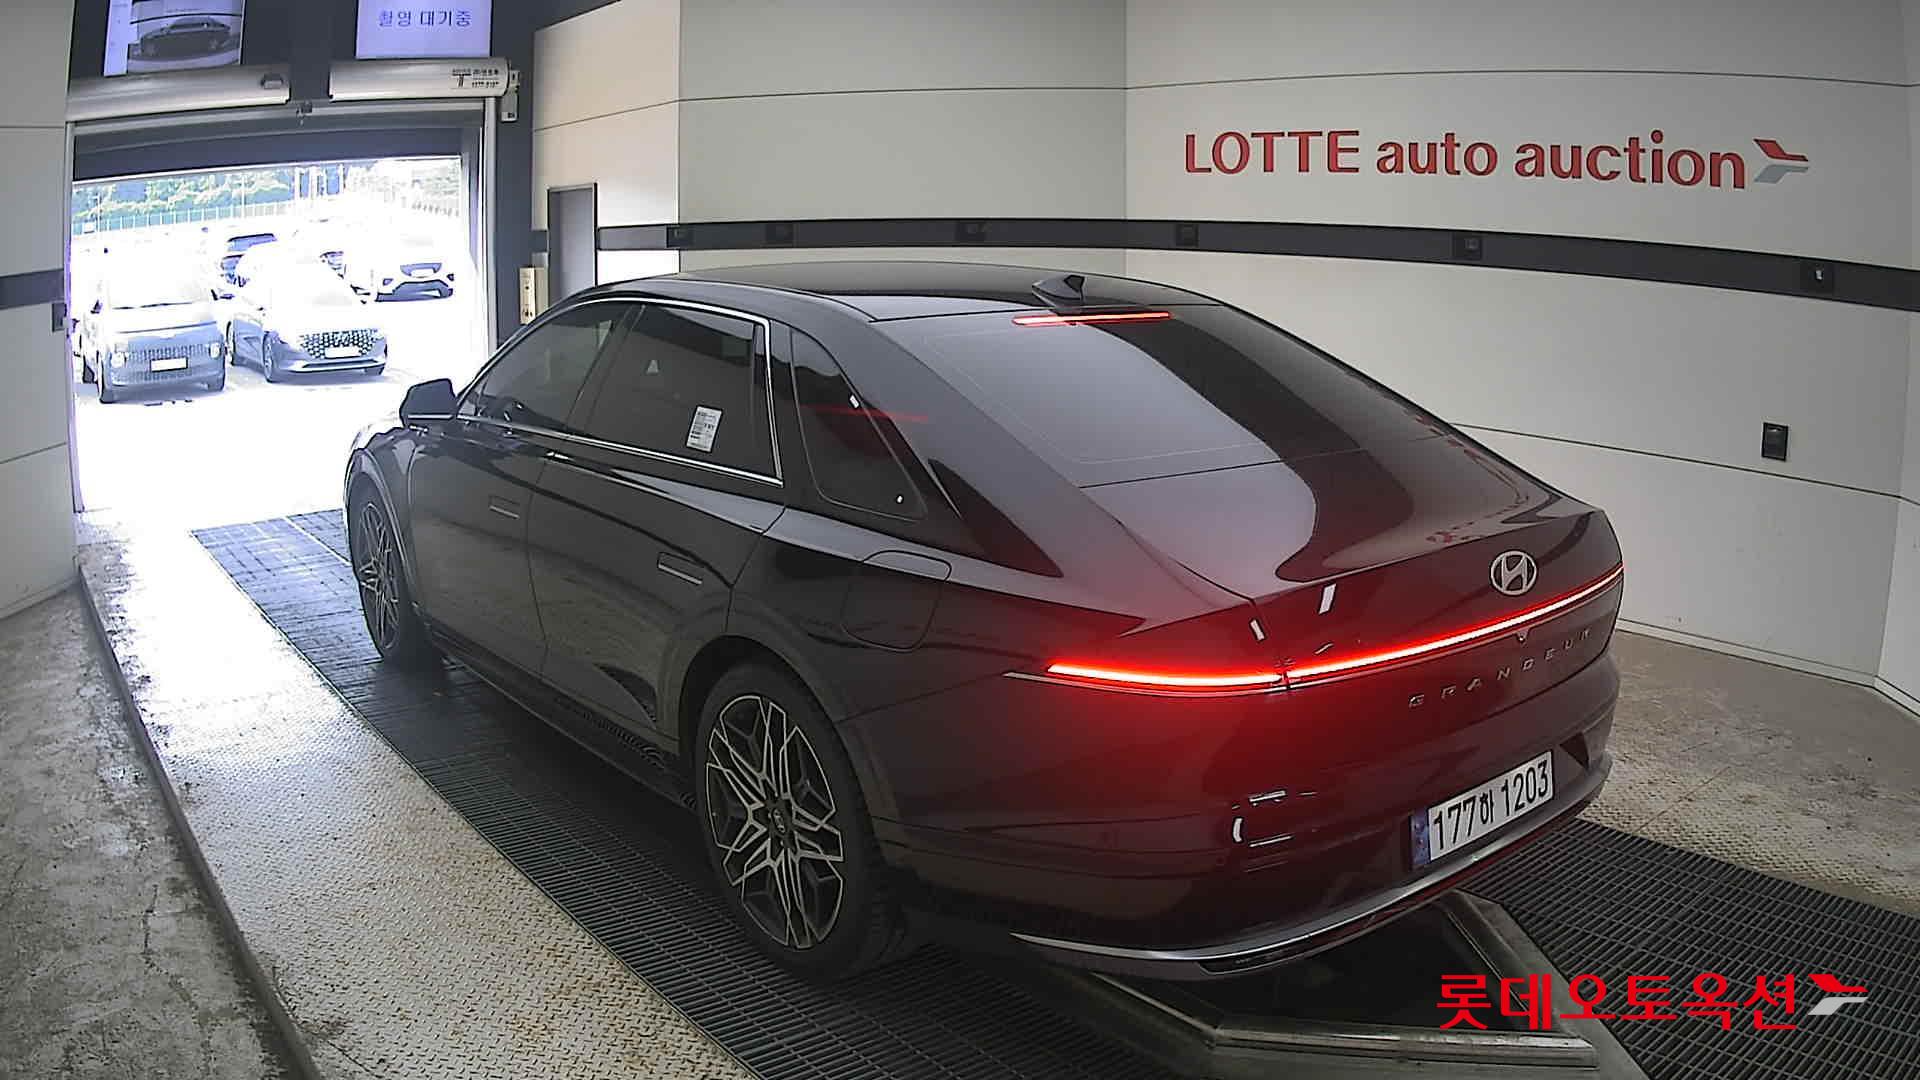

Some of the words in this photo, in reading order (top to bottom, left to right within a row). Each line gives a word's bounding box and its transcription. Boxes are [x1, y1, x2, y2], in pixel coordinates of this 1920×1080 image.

[420, 10, 471, 27] 대기중
[1184, 130, 1361, 174] LOTTE
[1376, 132, 1498, 177] auto
[1515, 130, 1746, 190] auction
[1433, 789, 1495, 850] 177하
[1501, 759, 1548, 817] 1203
